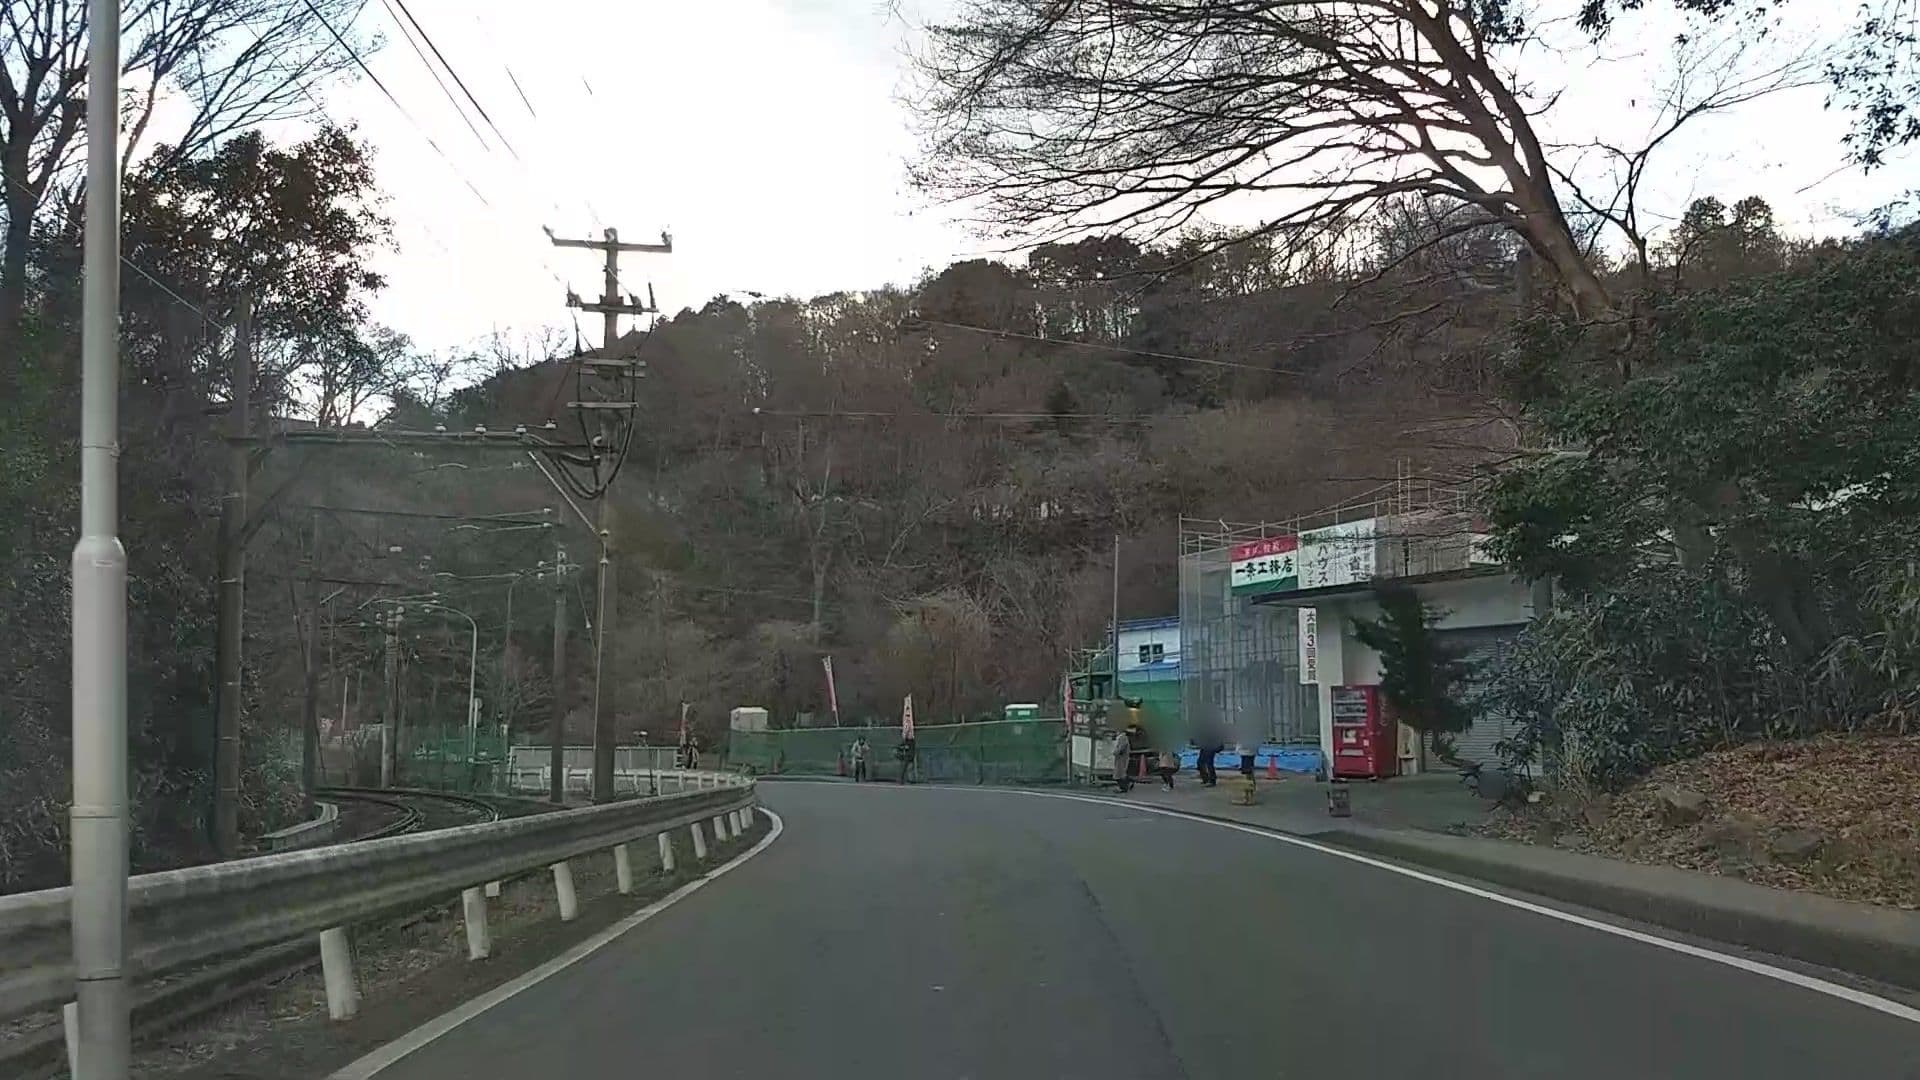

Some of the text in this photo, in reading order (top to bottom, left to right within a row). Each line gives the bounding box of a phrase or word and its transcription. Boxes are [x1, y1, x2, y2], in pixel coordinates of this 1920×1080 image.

[1235, 555, 1294, 581] 一条工務店
